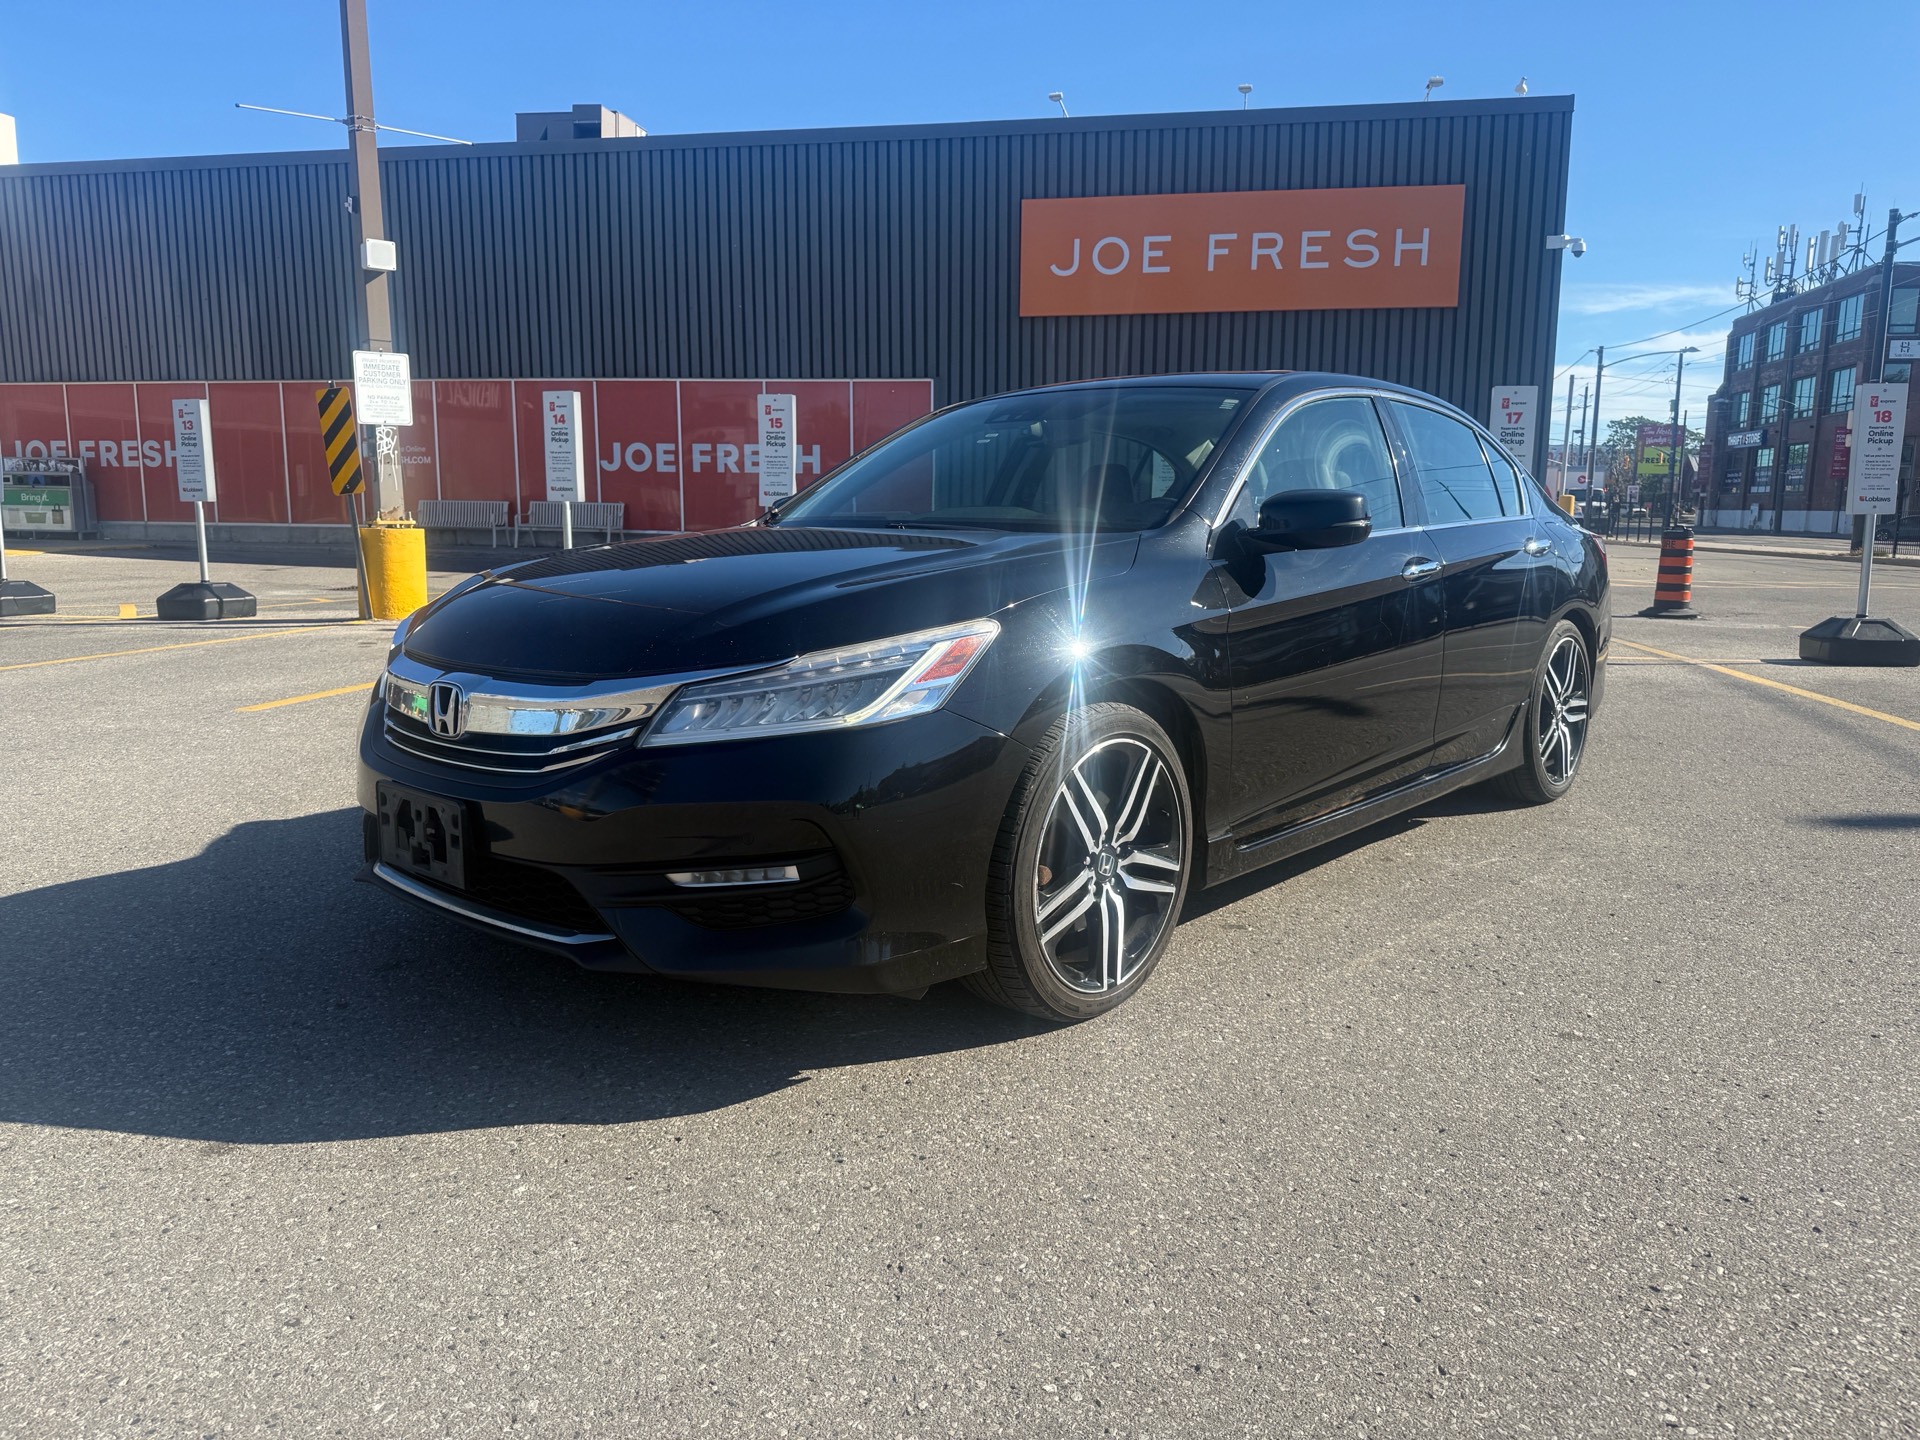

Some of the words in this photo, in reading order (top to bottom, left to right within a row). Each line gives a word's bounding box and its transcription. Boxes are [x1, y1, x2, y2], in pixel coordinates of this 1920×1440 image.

[1050, 235, 1171, 277] JOE
[1207, 228, 1430, 272] FRESH
[363, 363, 401, 372] IMMEDIATE
[363, 370, 401, 379] CUSTOMER
[358, 376, 388, 385] PARKING
[389, 378, 407, 386] ONLY
[552, 414, 566, 425] 14
[1505, 411, 1523, 424] 17
[1873, 410, 1893, 423] 18
[181, 420, 194, 431] 13
[768, 417, 783, 429] 15
[1500, 430, 1525, 438] Online
[1727, 435, 1743, 446] THRIFT
[1745, 432, 1761, 445] STORE
[1500, 438, 1525, 446] Pickup
[1867, 437, 1894, 446] Pickup
[600, 442, 676, 473] JOE
[692, 443, 821, 475] FREH
[21, 493, 41, 502] Bring
